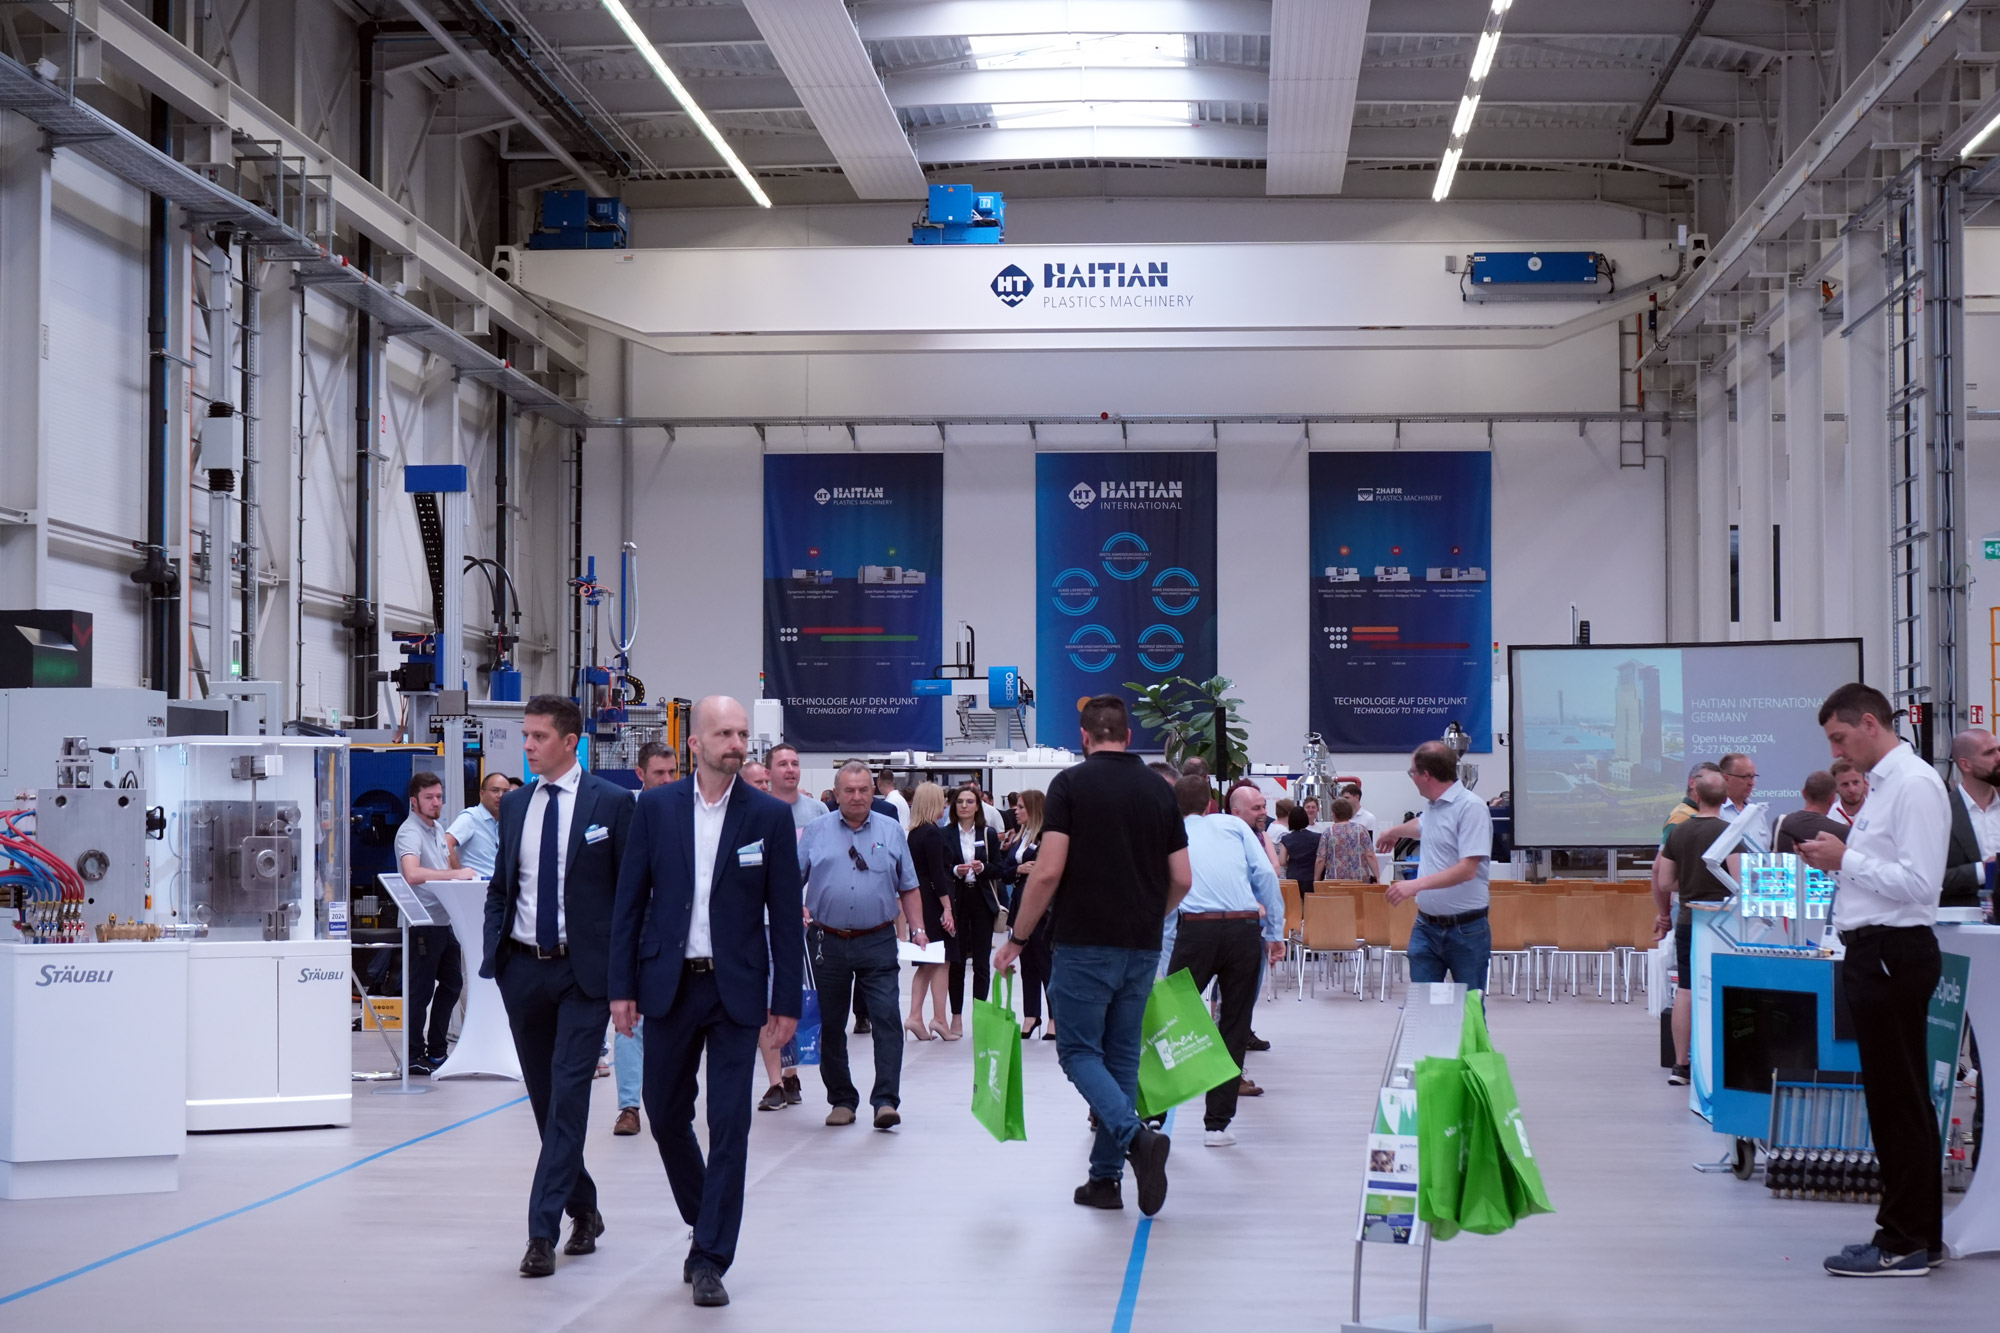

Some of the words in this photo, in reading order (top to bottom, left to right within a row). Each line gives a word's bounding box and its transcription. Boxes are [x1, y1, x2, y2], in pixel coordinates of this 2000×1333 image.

[1043, 262, 1168, 288] HAITIAN
[997, 276, 1027, 292] HT
[1043, 296, 1106, 308] PLASTICS
[1110, 295, 1194, 308] MACHINERY
[833, 487, 884, 498] HAITIAN
[1073, 490, 1091, 499] HT
[1100, 481, 1183, 498] HAITIAN
[1100, 502, 1183, 510] INTERNATIONAL
[1005, 672, 1014, 701] SEPRO
[869, 697, 887, 705] DEN
[890, 697, 919, 705] PUNKT
[1333, 697, 1396, 705] TECHNOLOGIE
[1398, 697, 1415, 705] AUF
[1417, 697, 1436, 705] DEN
[1438, 697, 1468, 705] PUNKT
[1691, 698, 1736, 709] HAITIAN
[1740, 697, 1828, 708] INTERNATIONA
[1691, 712, 1748, 722] GERMANY
[1692, 734, 1717, 744] Open
[1720, 734, 1748, 743] House
[1750, 734, 1776, 744] 2024,
[1751, 788, 1801, 798] Generation
[35, 964, 114, 987] STÄUBLI
[297, 968, 344, 983] STÄUBLI
